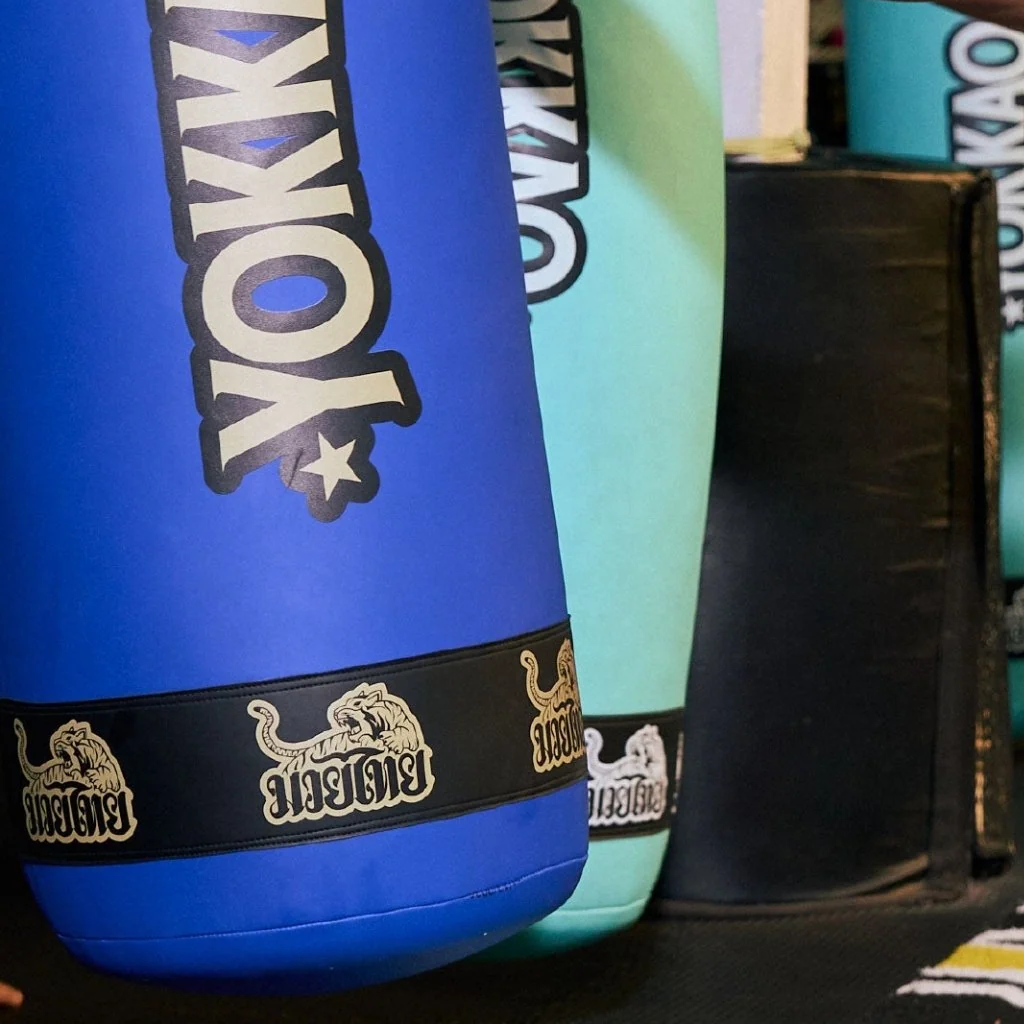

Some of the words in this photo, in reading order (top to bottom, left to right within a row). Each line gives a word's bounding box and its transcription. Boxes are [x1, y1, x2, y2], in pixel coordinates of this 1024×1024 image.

[24, 780, 132, 837] มวยไทย
[266, 746, 428, 819] มวยไทย
